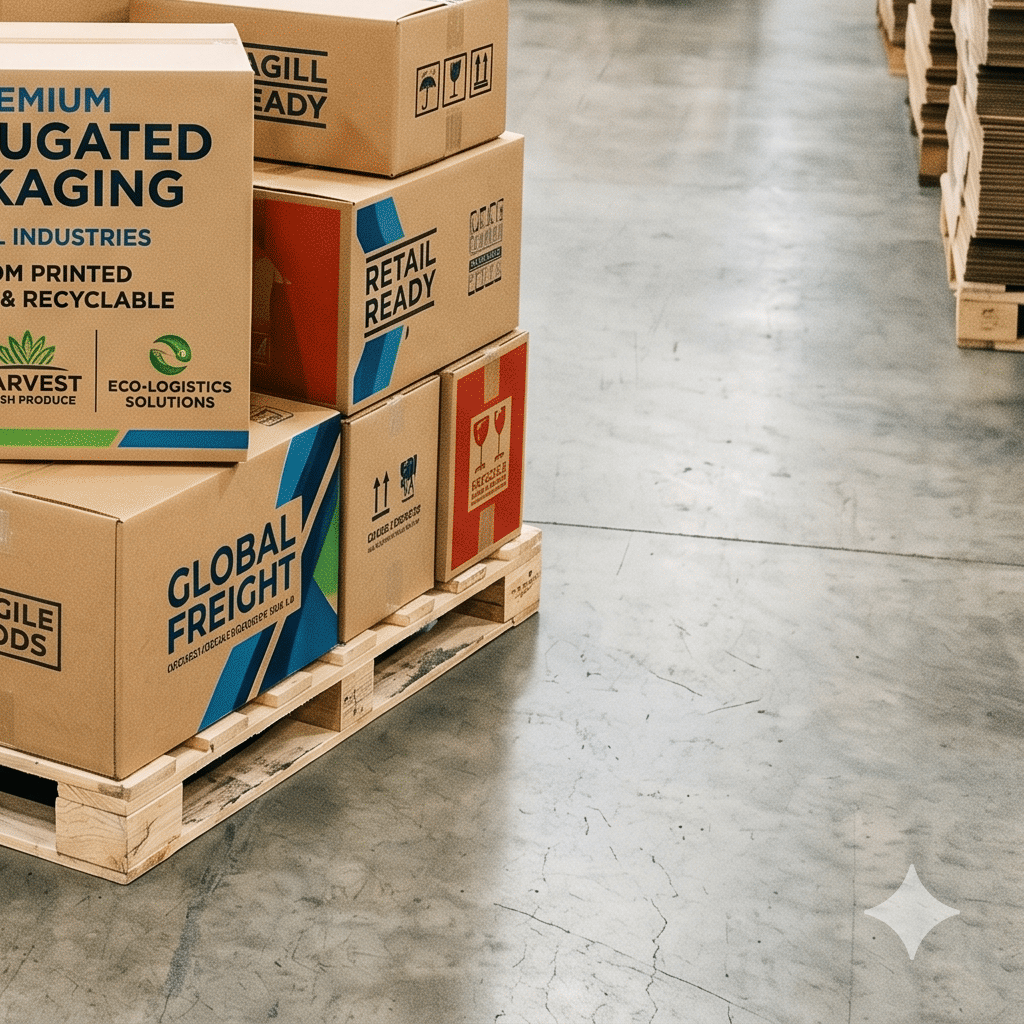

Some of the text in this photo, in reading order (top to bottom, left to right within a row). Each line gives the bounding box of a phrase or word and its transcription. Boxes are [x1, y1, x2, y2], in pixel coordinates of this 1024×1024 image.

[13, 227, 152, 247] INDUSTRIES
[31, 264, 133, 284] PRINTED
[365, 239, 437, 297] RETAIL
[0, 289, 16, 308] &
[23, 290, 175, 309] RECYCLABLE
[364, 268, 437, 329] READY
[108, 379, 233, 395] ECO-LOGISTICS
[18, 394, 77, 406] PRODUCE
[125, 395, 216, 409] SOLUTIONS
[167, 514, 296, 609] GLOBAL
[167, 552, 296, 656] FREIGHT
